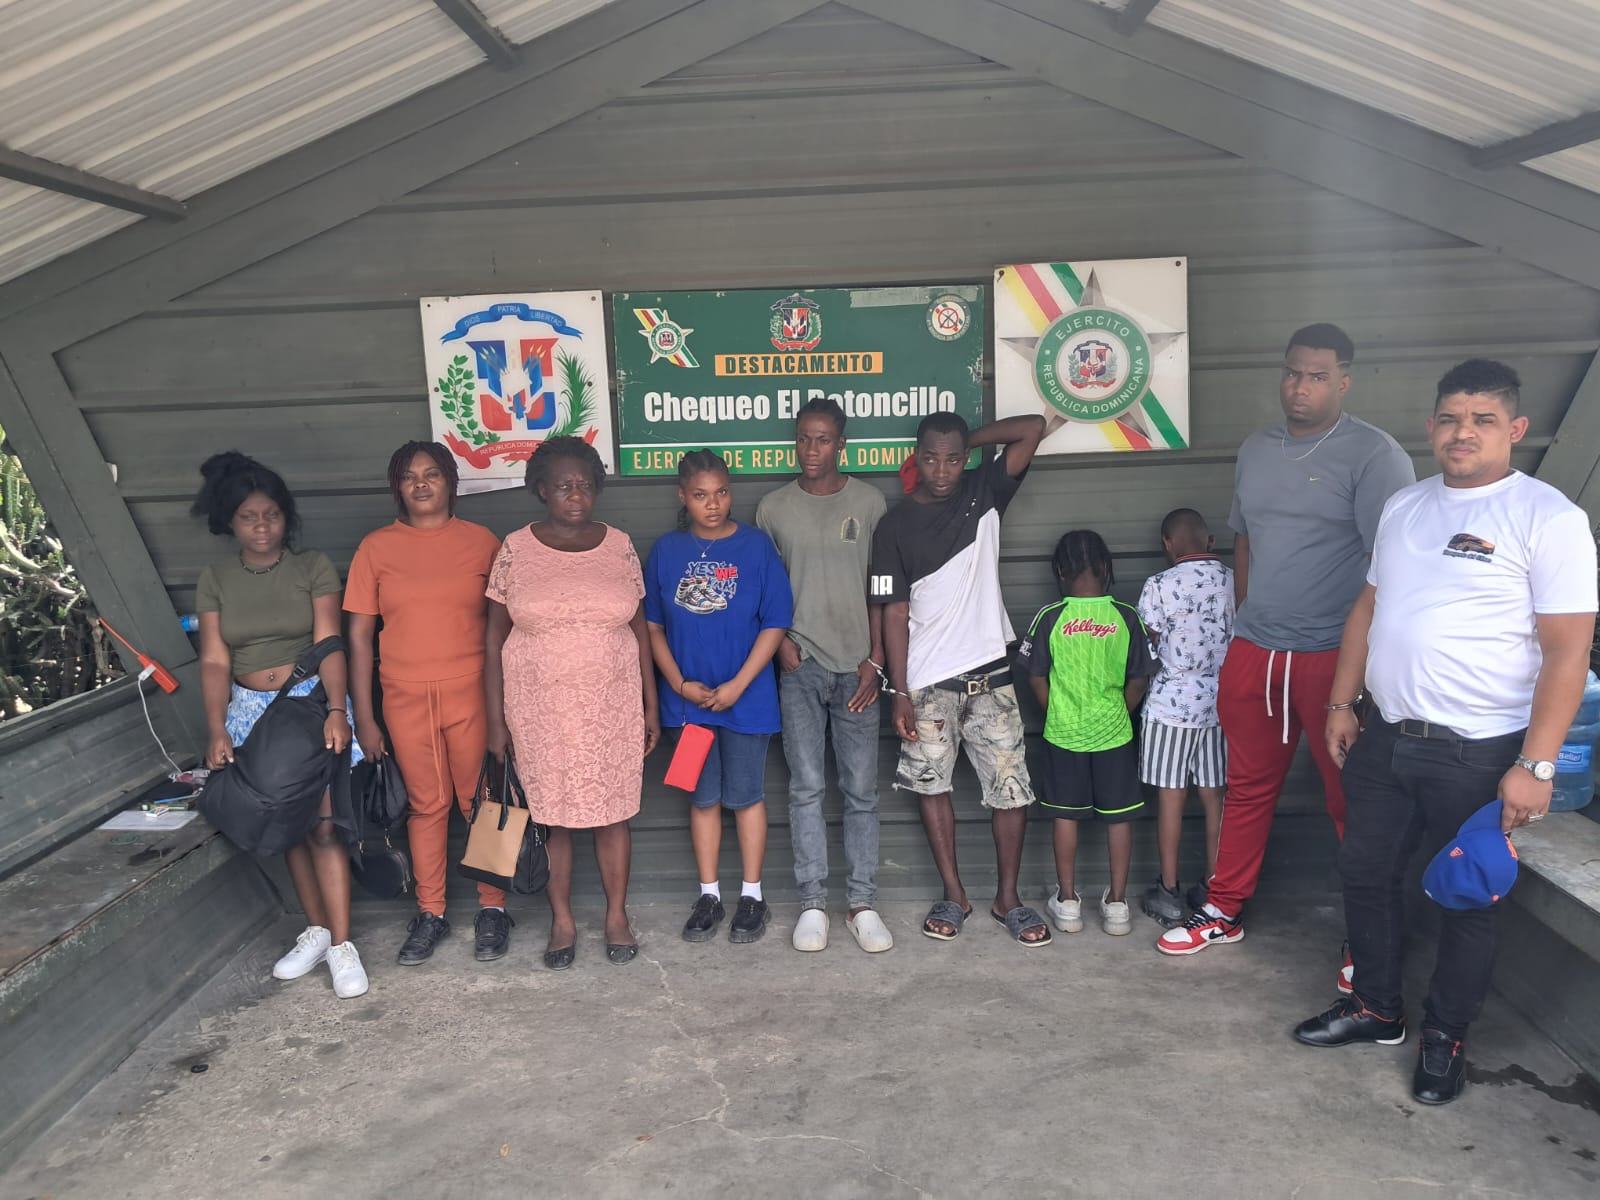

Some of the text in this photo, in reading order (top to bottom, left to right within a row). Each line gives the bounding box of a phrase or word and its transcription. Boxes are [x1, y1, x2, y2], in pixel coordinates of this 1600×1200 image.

[497, 305, 521, 313] PATRIA
[1055, 315, 1130, 341] EJERCITO
[725, 354, 873, 374] DESTACAMENTO
[1043, 358, 1144, 414] REPUBLICA DOMINICANA
[644, 386, 956, 424] Chequeo El toncillo
[633, 451, 686, 470] EJERC
[723, 449, 744, 468] DE
[752, 447, 849, 468] REPUA
[688, 561, 738, 582] YES WE
[1062, 617, 1118, 638] Kellogg's
